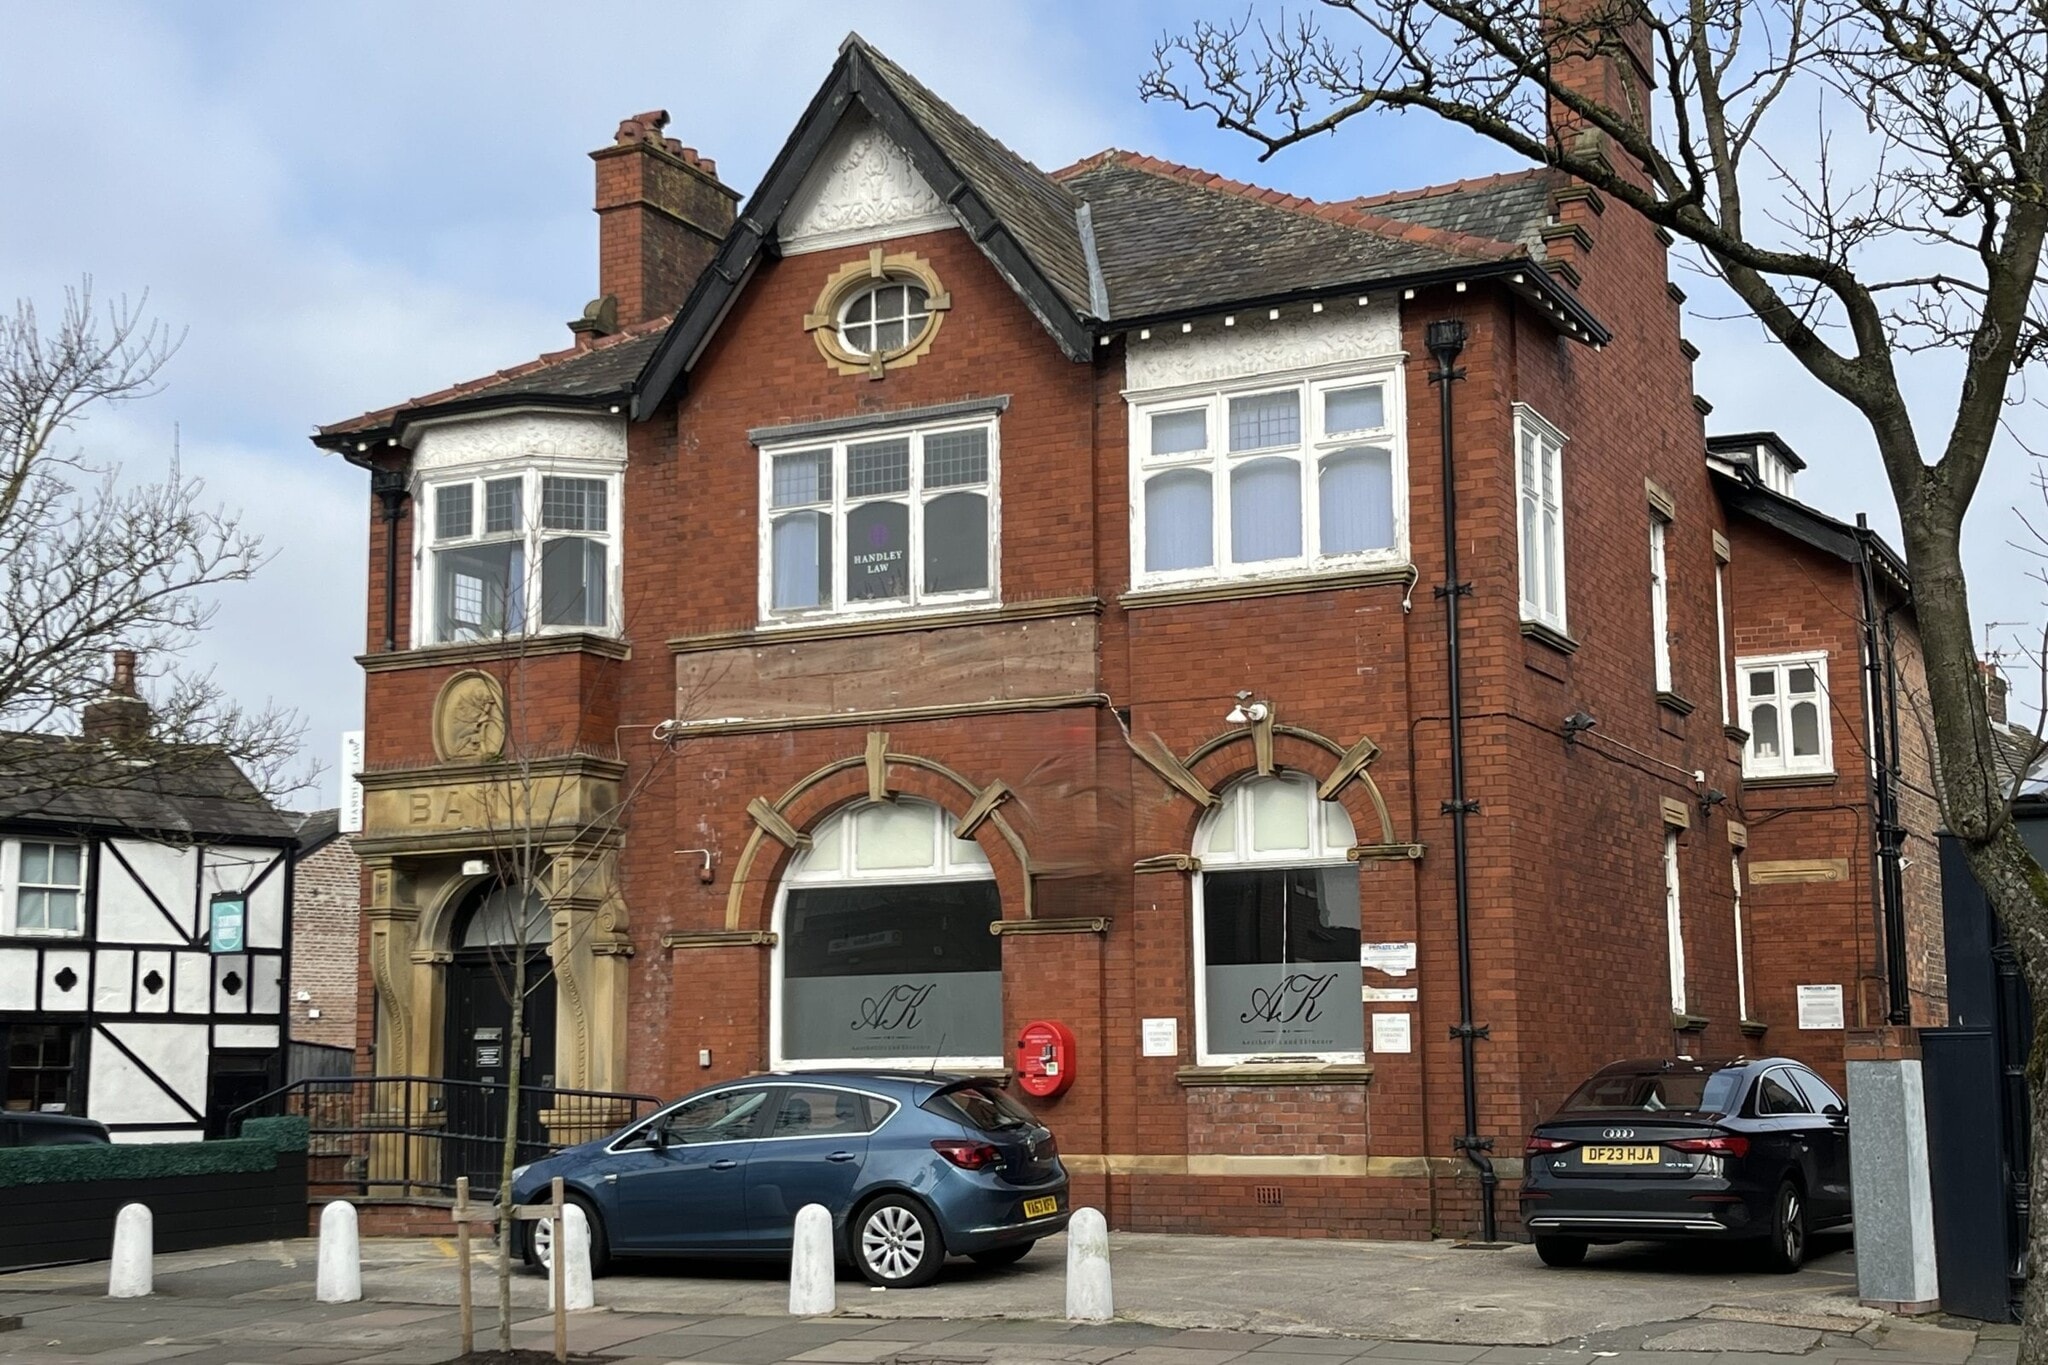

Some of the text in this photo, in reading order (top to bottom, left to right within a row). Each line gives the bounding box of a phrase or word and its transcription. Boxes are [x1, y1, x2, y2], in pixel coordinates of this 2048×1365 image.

[854, 550, 902, 564] HANDLEY
[867, 563, 889, 574] LAW
[350, 768, 359, 825] HANDL
[851, 983, 937, 1030] AK
[1240, 973, 1338, 1023] AK
[1589, 1147, 1654, 1161] DF23 HJA
